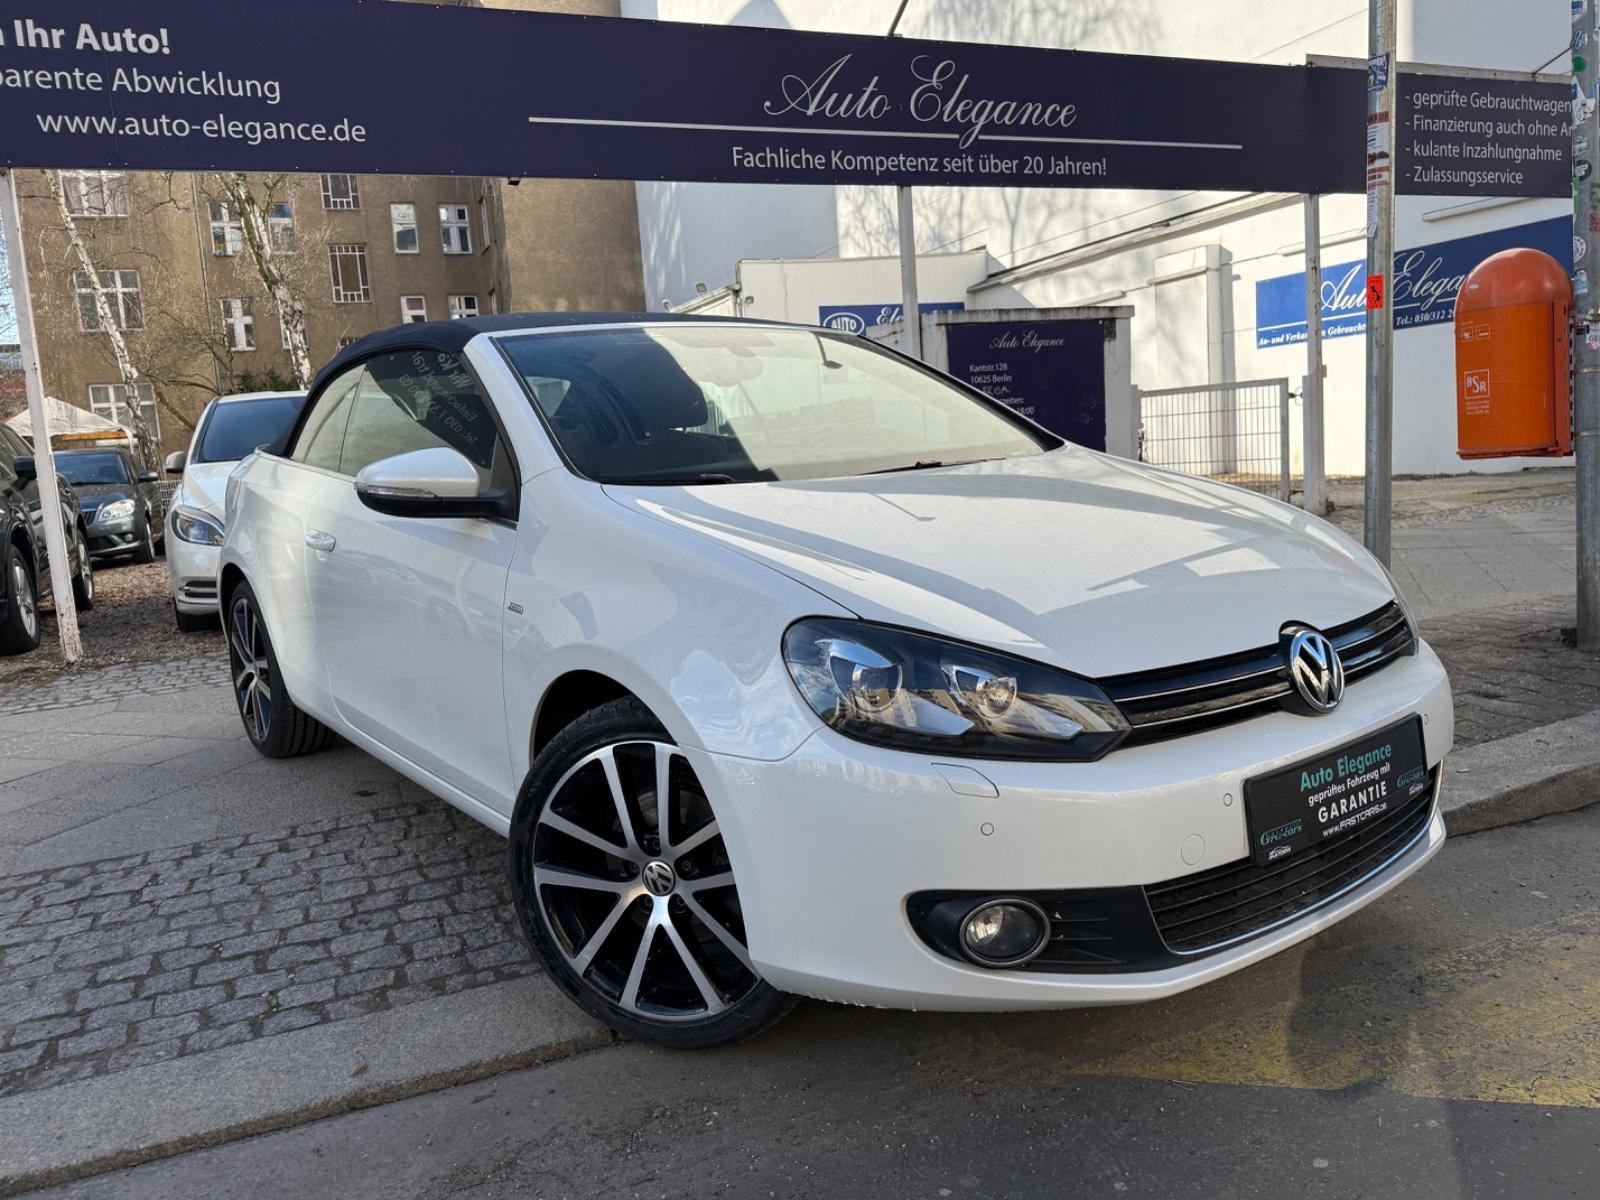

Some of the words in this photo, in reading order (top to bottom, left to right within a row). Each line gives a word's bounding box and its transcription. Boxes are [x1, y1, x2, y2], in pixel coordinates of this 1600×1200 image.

[14, 18, 65, 49] Ihr
[76, 23, 170, 55] Auto!
[0, 67, 103, 91] arente
[111, 68, 281, 104] Abwicklung
[763, 53, 892, 120] Auto
[908, 54, 1079, 149] Elegance
[1413, 90, 1468, 109] geprüfte
[1470, 92, 1572, 116] Gebrauchtwagen
[36, 113, 367, 144] www.auto-elegance.de
[1413, 116, 1493, 138] Finanzierung
[1496, 120, 1525, 135] auch
[1528, 120, 1558, 136] ohne
[732, 146, 826, 172] Fachliche
[831, 149, 939, 176] Kompetenz
[942, 152, 975, 175] seit
[978, 152, 1019, 176] über
[1023, 156, 1045, 175] 20
[1048, 155, 1108, 177] Jahren!
[1413, 140, 1460, 158] kulante
[1462, 142, 1562, 163] Inzahlungnahme
[1413, 165, 1524, 187] Zulassungsservice
[989, 331, 1019, 350] Auto
[1022, 329, 1066, 353] Elegance
[992, 373, 1013, 383] Berlin
[1466, 375, 1487, 393] BSR
[1300, 771, 1334, 793] Auto
[1336, 744, 1392, 777] Elegance
[1308, 783, 1346, 808] geprüftes
[1346, 770, 1379, 791] Fahrzeug
[1379, 762, 1391, 777] mit
[1318, 780, 1388, 823] GARANTIE
